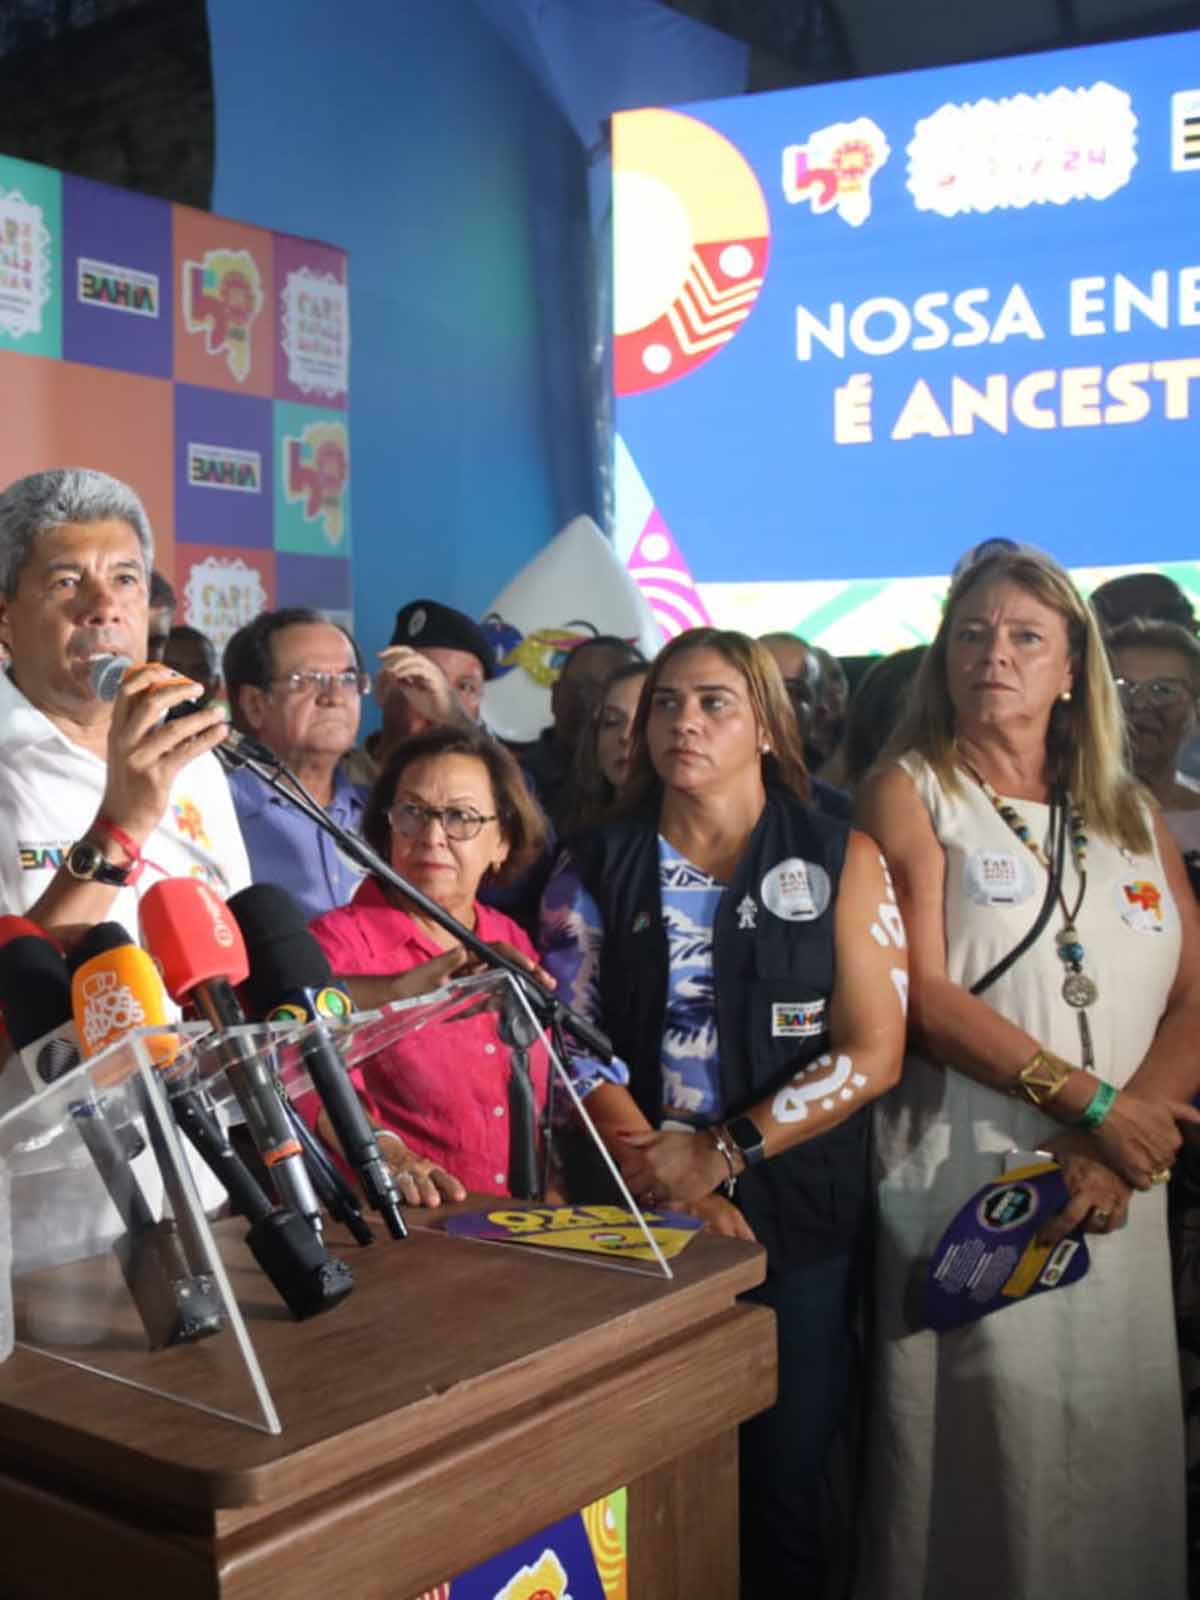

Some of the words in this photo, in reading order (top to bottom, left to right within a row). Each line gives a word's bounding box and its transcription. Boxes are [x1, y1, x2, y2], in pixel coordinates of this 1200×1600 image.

[796, 283, 1046, 361] NOSSA
[834, 372, 873, 445] É
[890, 356, 1200, 441] ANCEST
